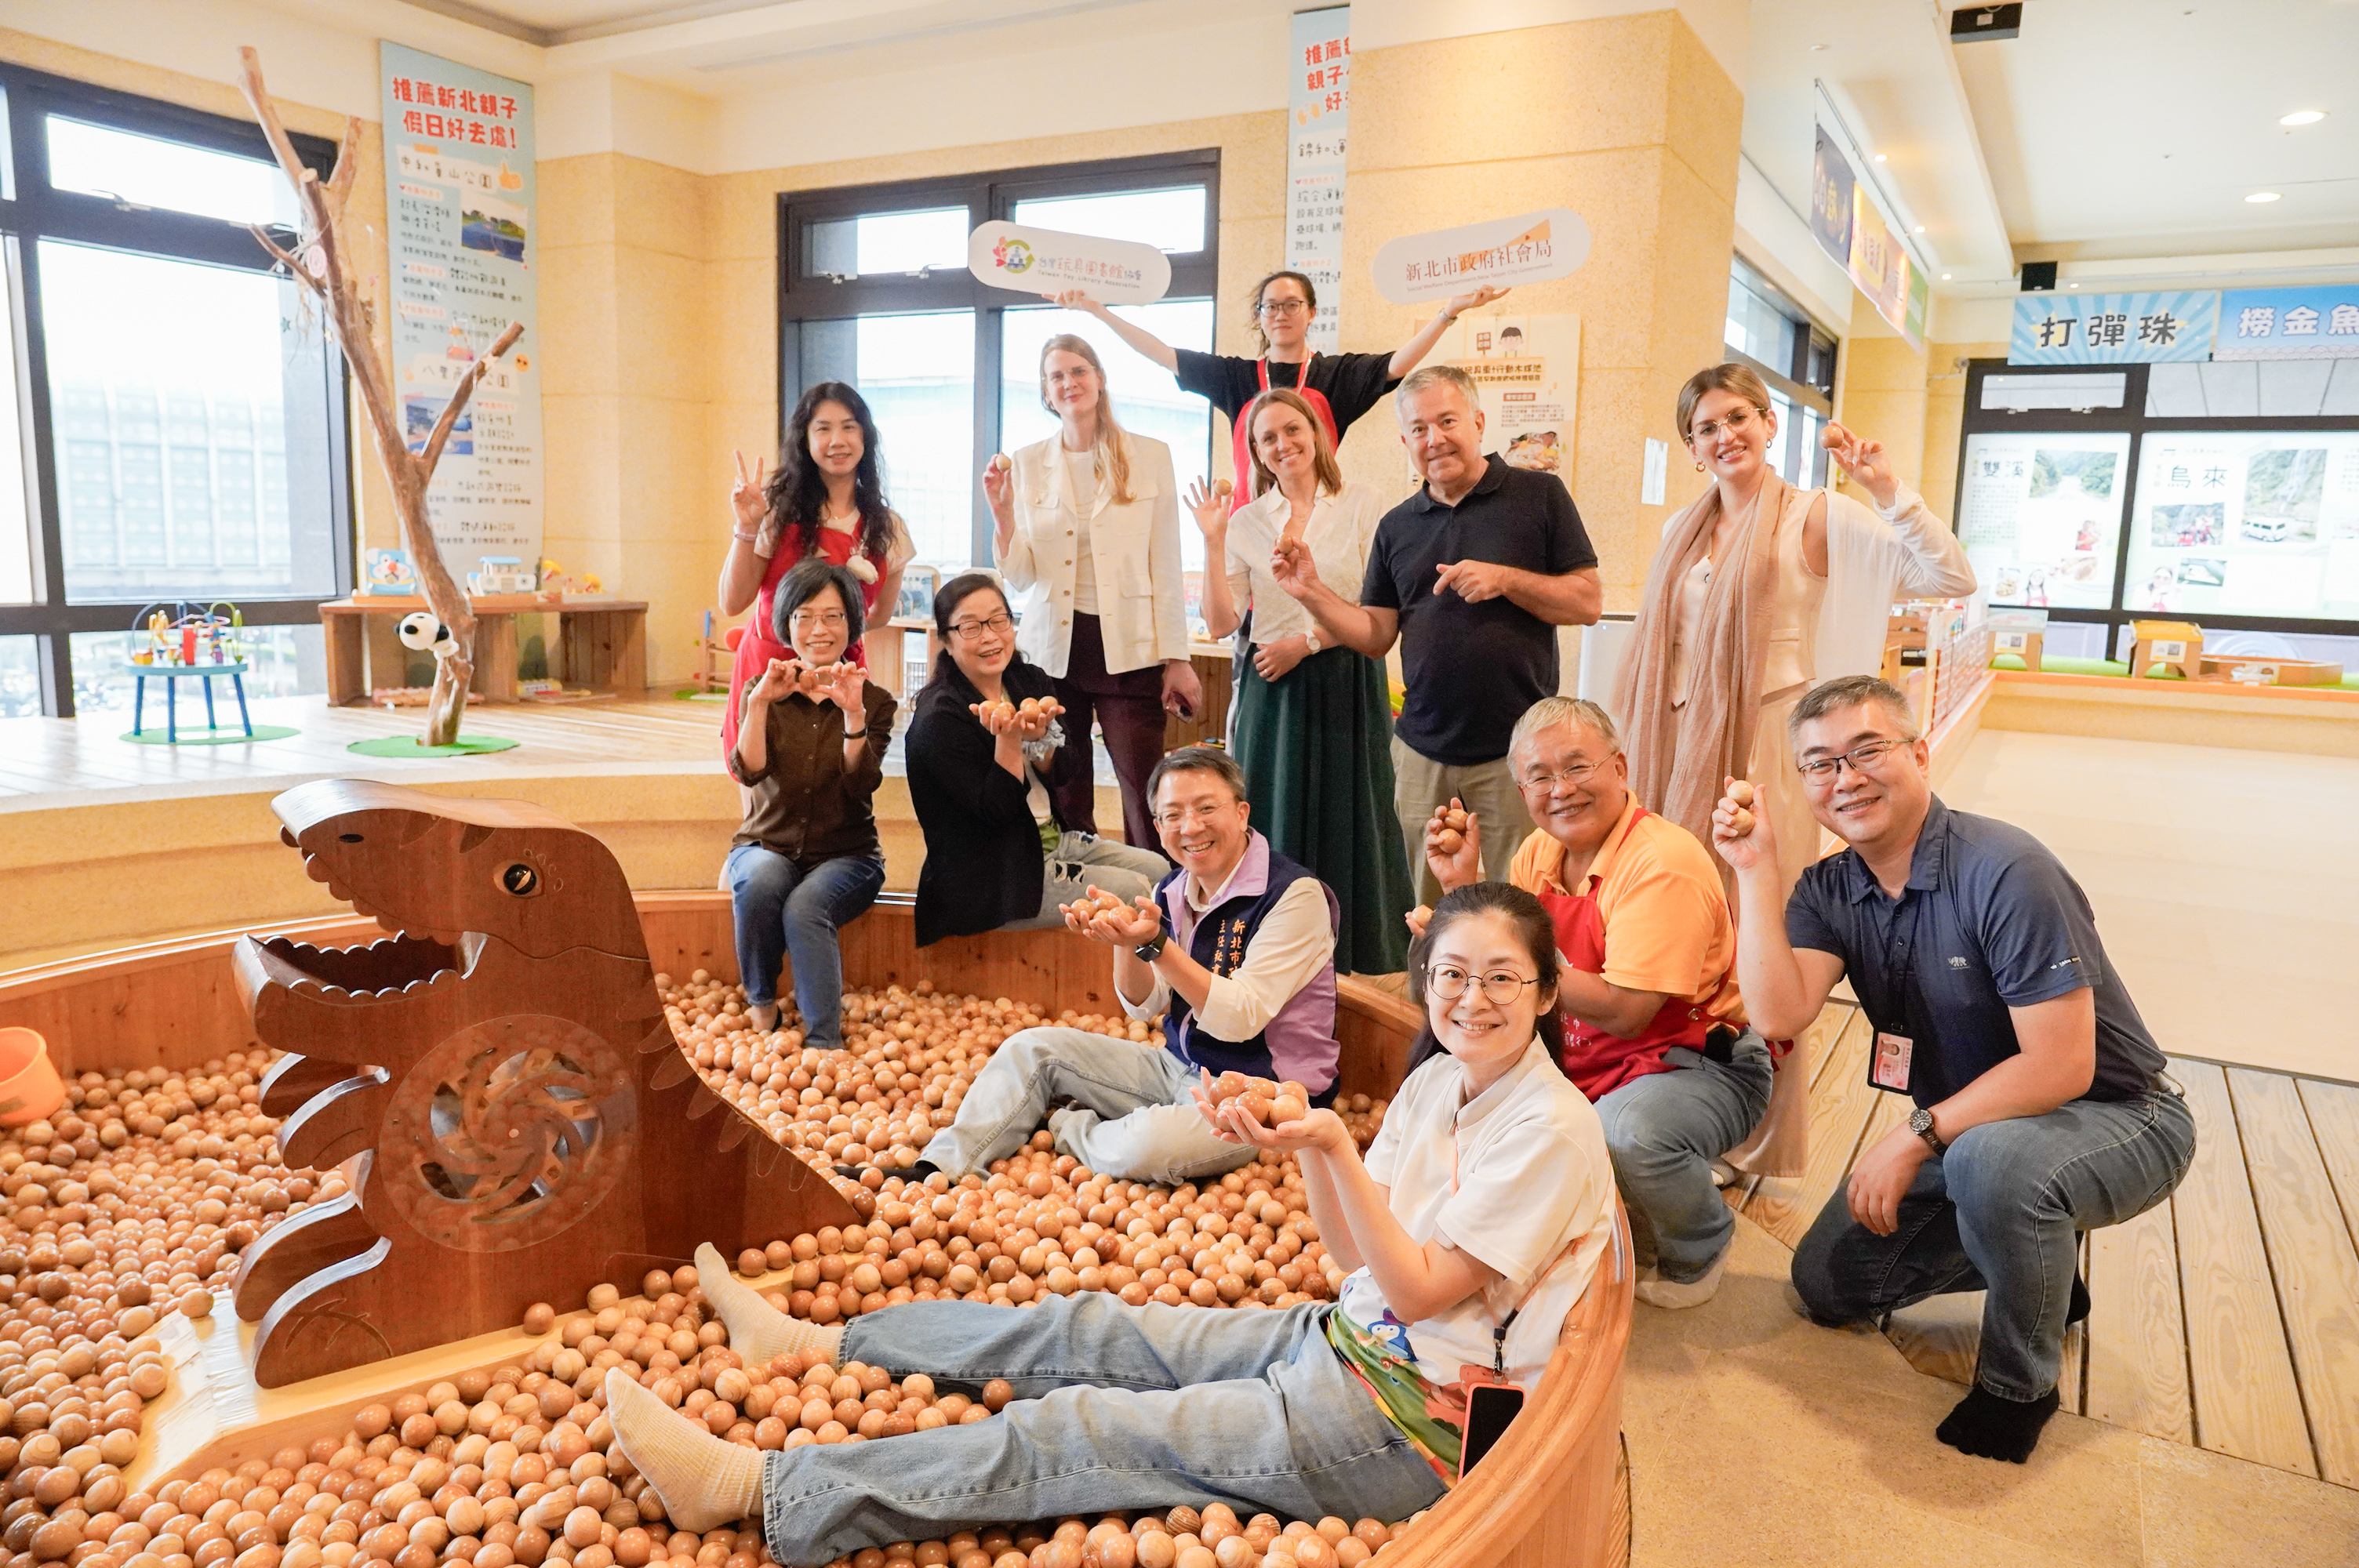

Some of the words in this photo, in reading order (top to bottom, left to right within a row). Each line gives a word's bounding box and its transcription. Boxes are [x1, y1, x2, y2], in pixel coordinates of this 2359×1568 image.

[1307, 65, 1349, 90] 親子
[393, 77, 518, 119] 推薦新北親子
[1038, 257, 1142, 281] 台灣玩具圖書館協會
[1406, 238, 1552, 281] 新北市政府社會局
[2041, 313, 2176, 347] 打彈珠
[2237, 303, 2359, 338] 撈金魚
[1983, 461, 2024, 478] 雙溪
[2167, 465, 2227, 488] 烏來
